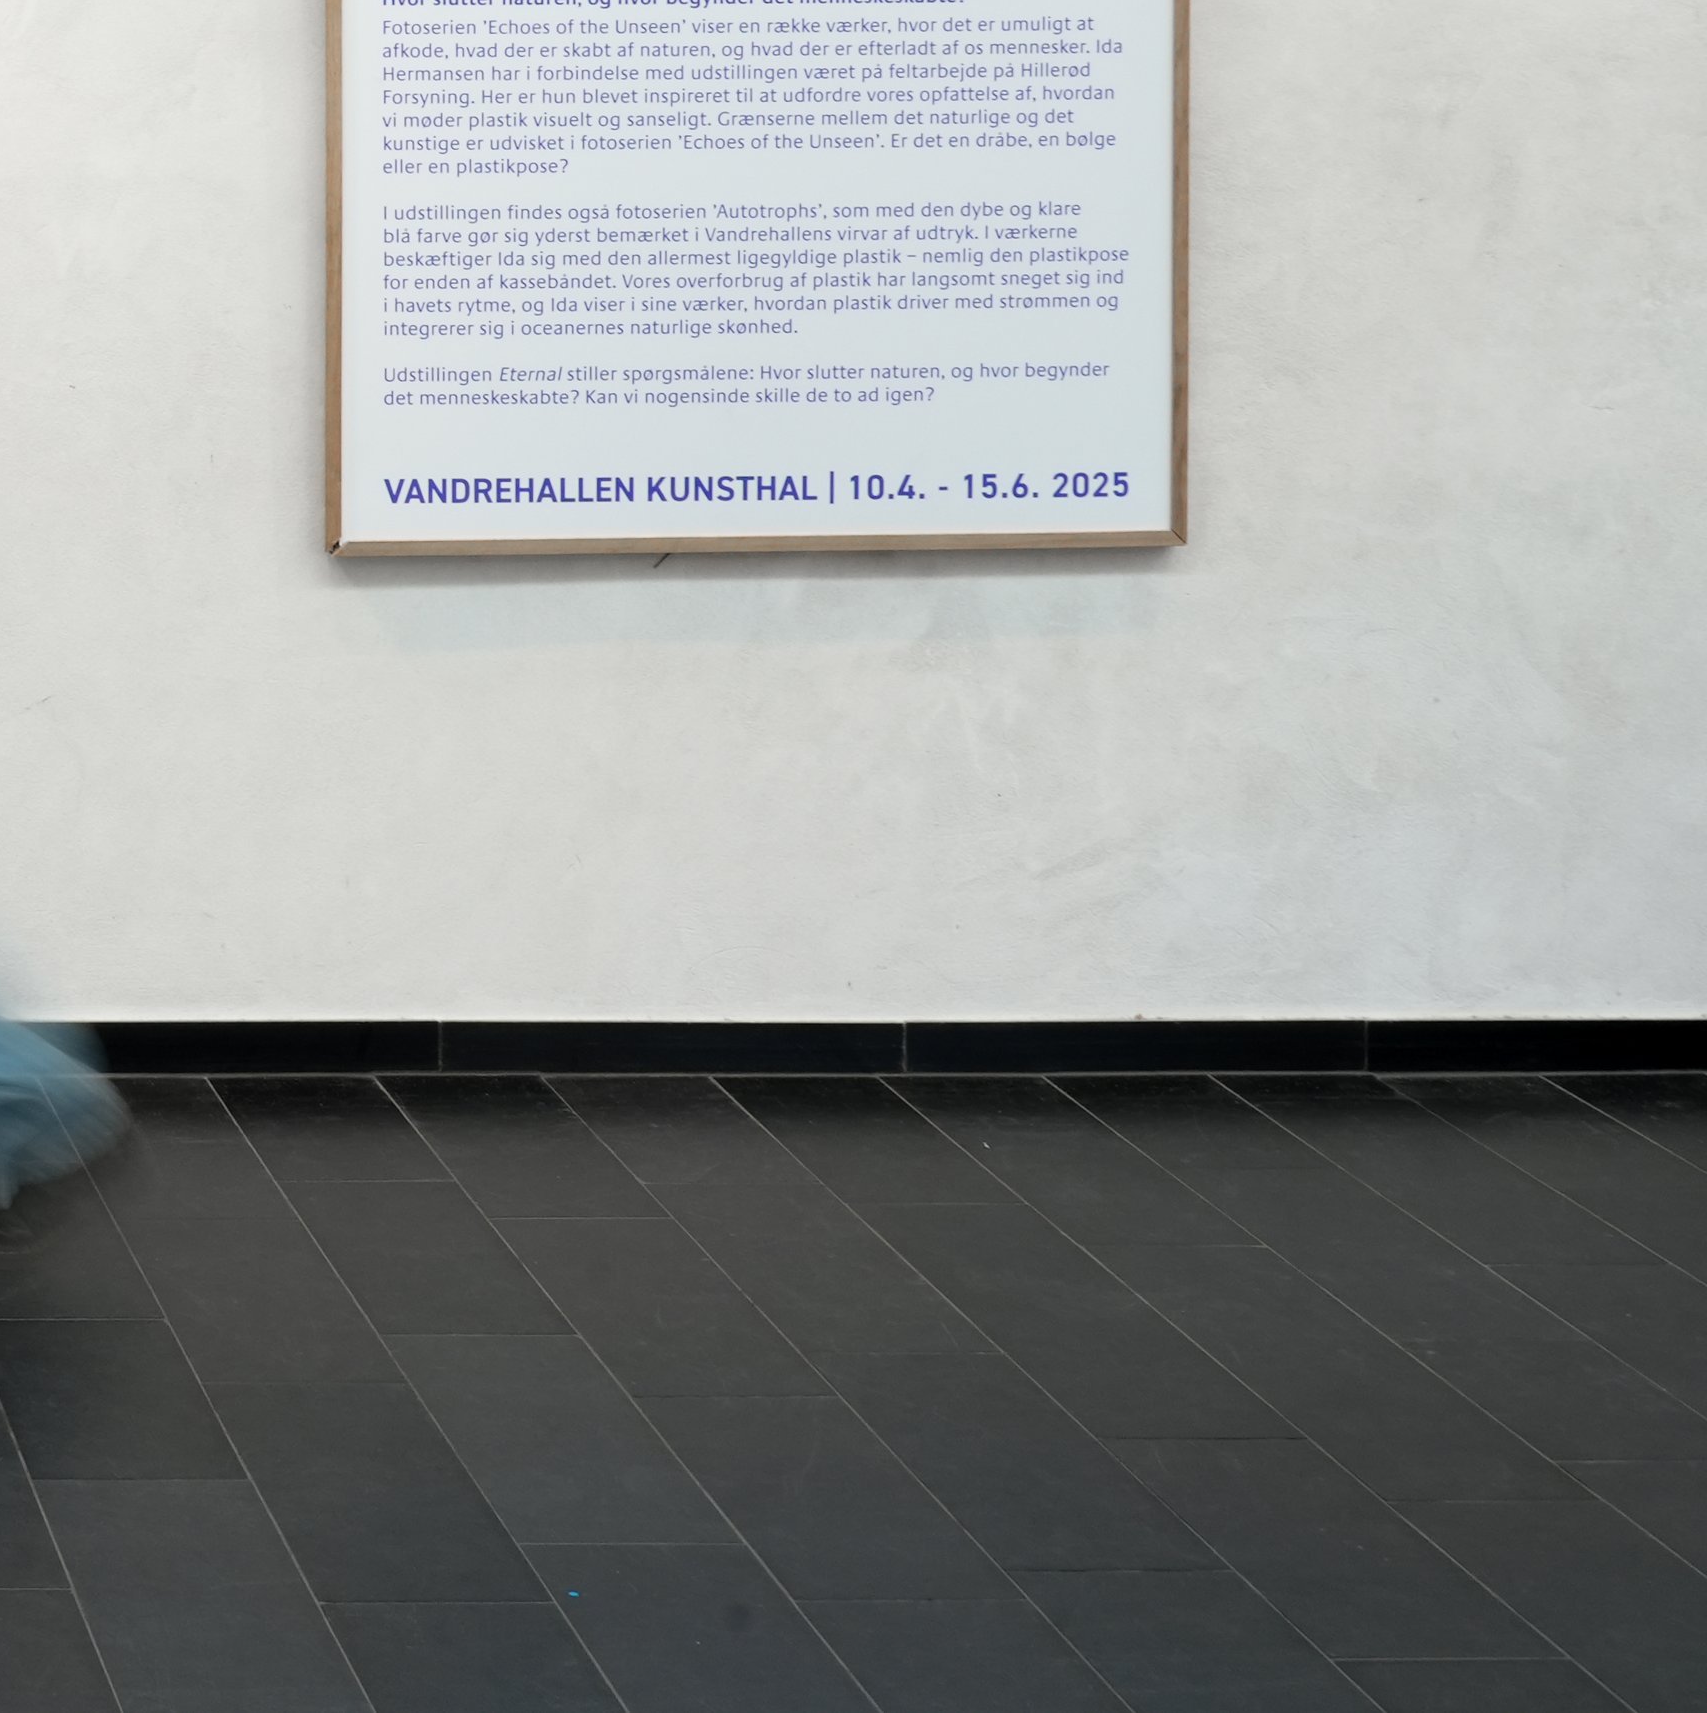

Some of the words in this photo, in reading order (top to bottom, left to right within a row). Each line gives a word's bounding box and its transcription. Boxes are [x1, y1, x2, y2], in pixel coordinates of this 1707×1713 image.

[382, 66, 485, 82] Hermansen
[491, 65, 522, 82] har
[526, 65, 531, 81] i
[535, 64, 640, 82] forbindelse
[645, 64, 685, 81] med
[690, 63, 798, 84] udstillingen
[802, 64, 857, 80] været
[861, 62, 884, 84] på
[887, 62, 988, 83] feltarbejde
[992, 62, 1015, 83] på
[1020, 61, 1091, 78] Hillerød
[382, 158, 424, 175] eller
[427, 161, 450, 175] en
[456, 158, 569, 179] plastikpose?
[382, 273, 410, 291] for
[413, 273, 471, 291] enden
[475, 273, 495, 290] af
[499, 272, 617, 290] kassebåndet.
[621, 273, 671, 290] Vores
[675, 272, 784, 293] overforbrug
[789, 271, 808, 288] af
[812, 271, 872, 292] plastik
[876, 271, 907, 288] har
[911, 270, 996, 291] langsomt
[1000, 270, 1062, 290] sneget
[1065, 269, 1091, 290] sig
[1096, 268, 1125, 285] ind
[383, 320, 475, 341] integrerer
[478, 319, 505, 340] sig
[510, 319, 516, 336] i
[520, 321, 625, 336] oceanernes
[629, 318, 713, 339] naturlige
[716, 318, 799, 336] skønhed.
[383, 366, 493, 387] Udstillingen
[498, 365, 564, 383] Eternal
[566, 365, 619, 382] stiller
[622, 364, 755, 386] spørgsmålene:
[759, 364, 803, 381] Hvor
[806, 363, 866, 381] slutter
[870, 364, 946, 381] naturen,
[950, 366, 974, 383] og
[979, 362, 1020, 379] hvor
[1024, 361, 1111, 382] begynder
[383, 389, 415, 406] det
[419, 388, 580, 407] menneskeskabte?
[585, 389, 618, 405] Kan
[623, 388, 639, 405] vi
[644, 387, 751, 408] nogensinde
[754, 386, 802, 404] skille
[804, 386, 829, 404] de
[833, 387, 853, 403] to
[857, 386, 880, 403] ad
[884, 386, 935, 407] igen?
[382, 476, 635, 505] VANDREHALLEN
[646, 474, 819, 503] KUNSTHAL
[849, 473, 926, 501] 10.4.
[963, 472, 1040, 500] 15.6.
[1051, 471, 1130, 499] 2025
